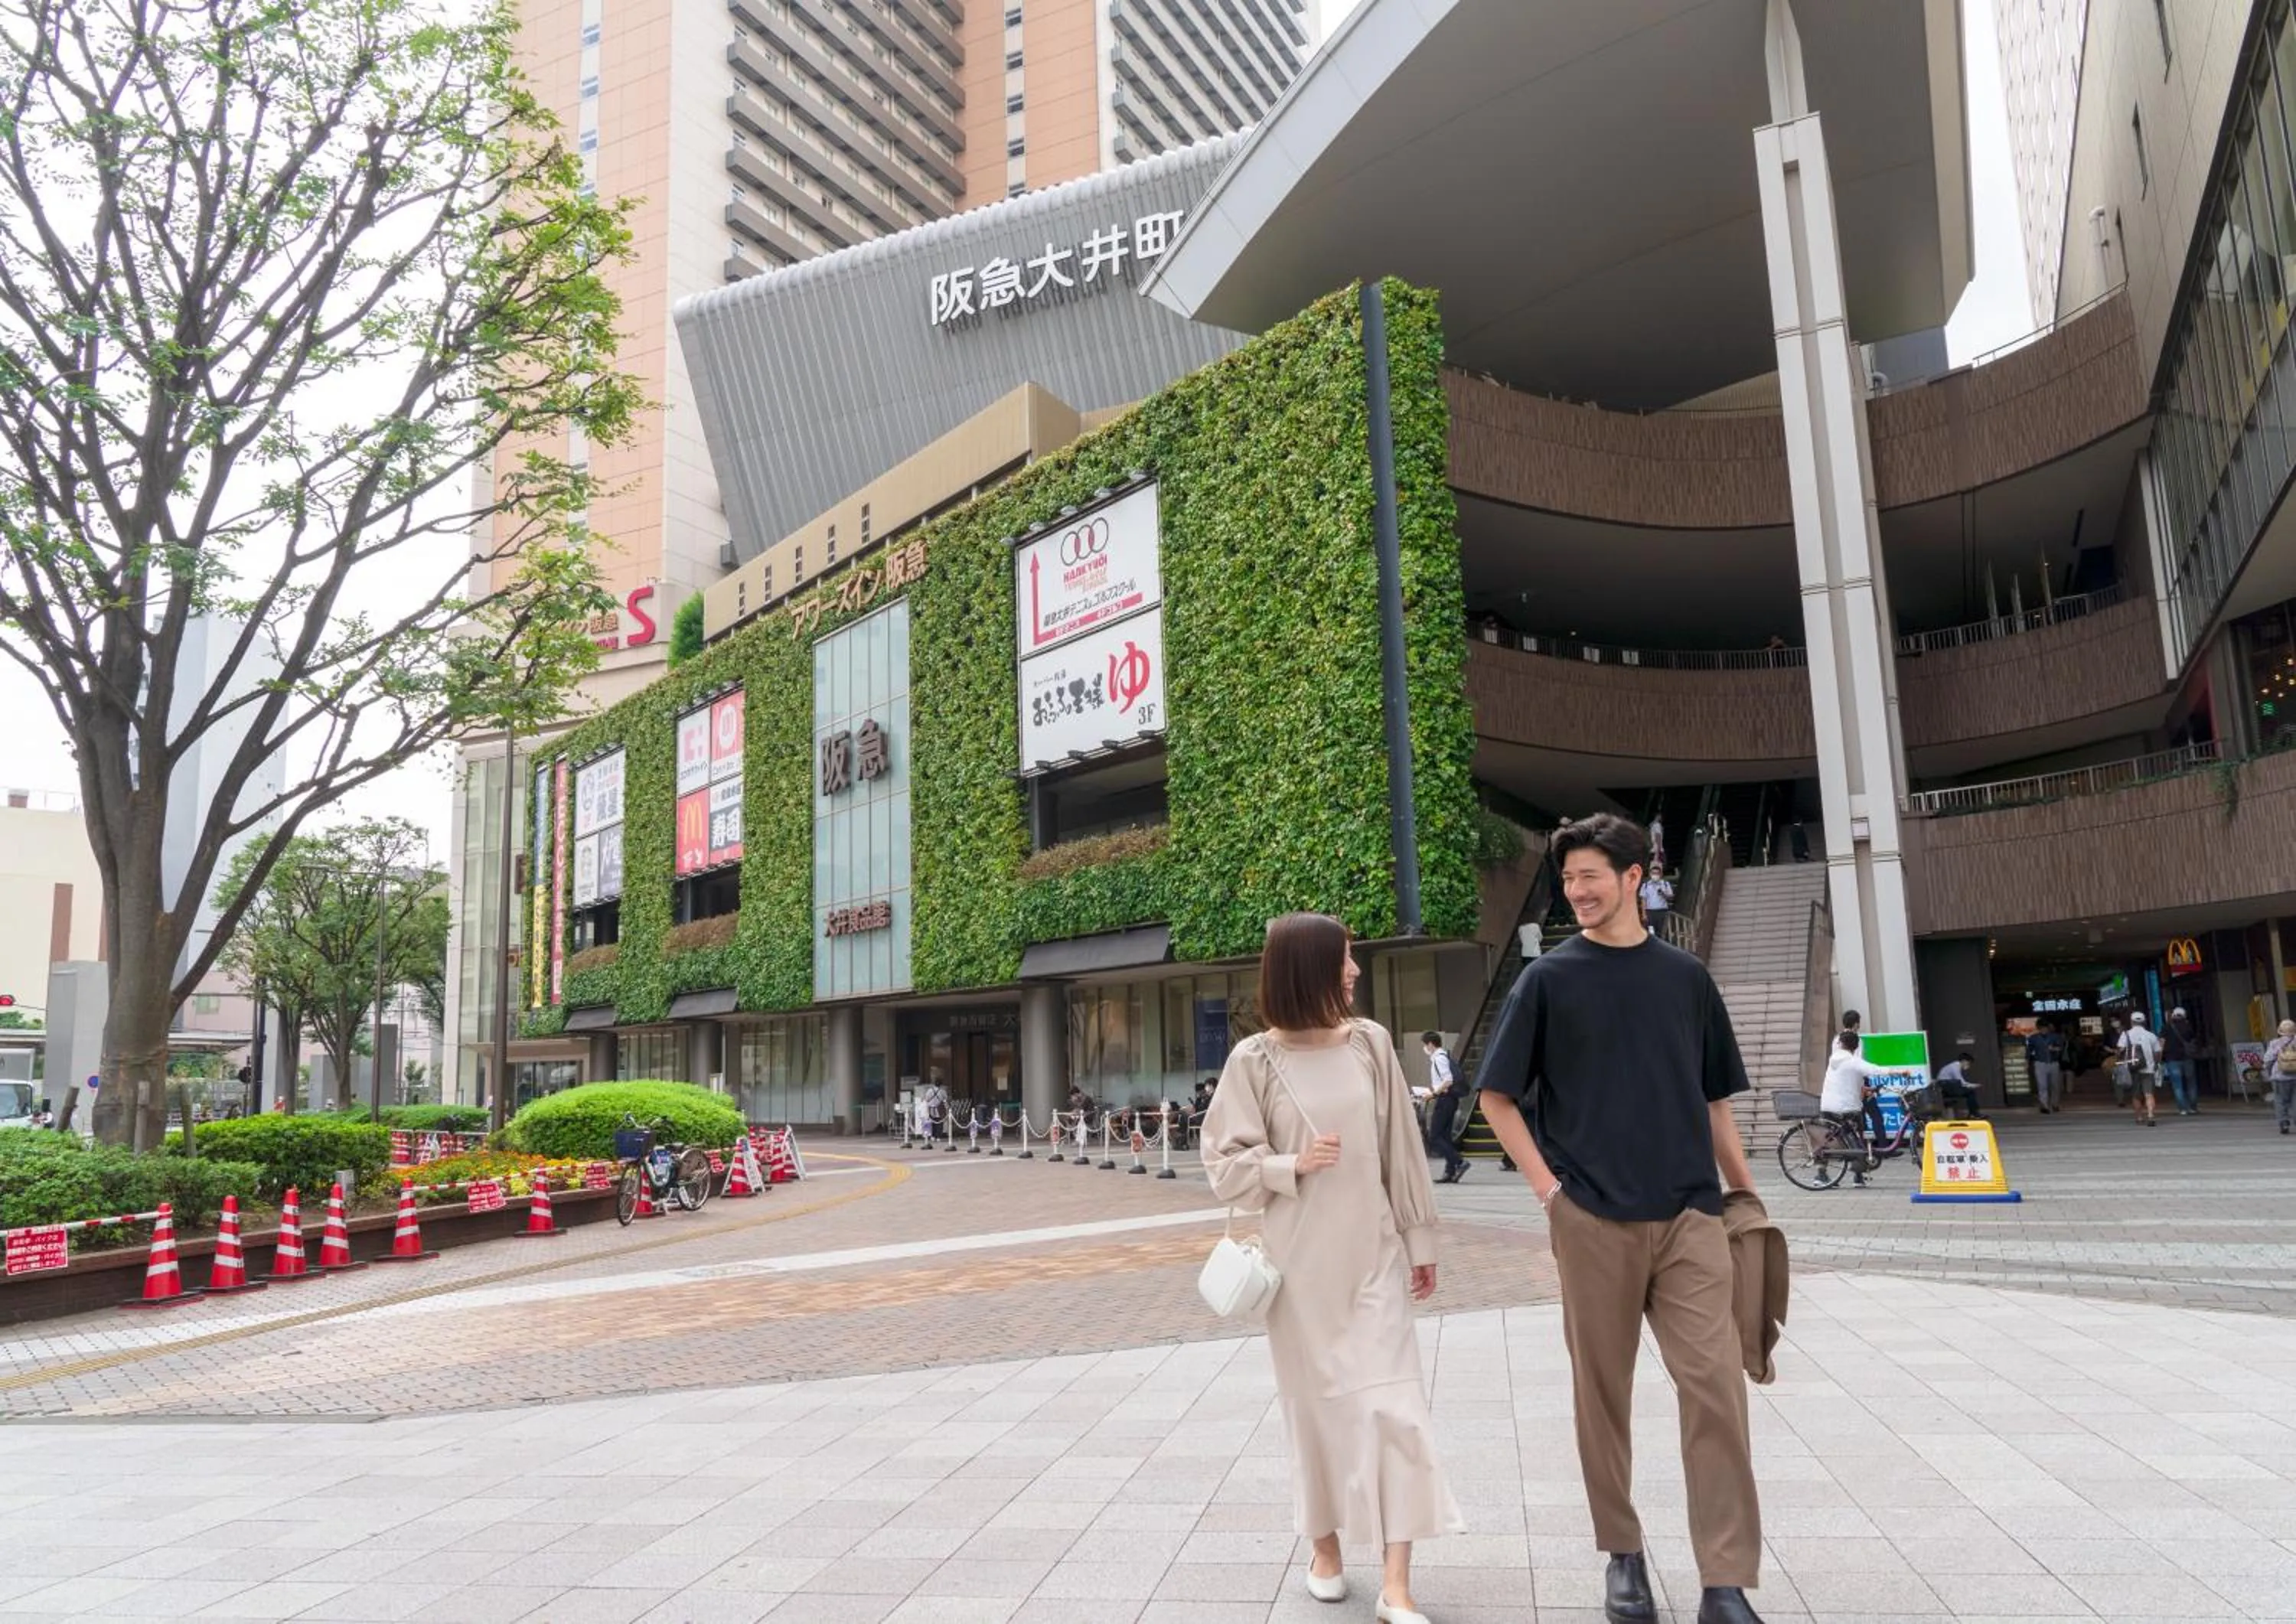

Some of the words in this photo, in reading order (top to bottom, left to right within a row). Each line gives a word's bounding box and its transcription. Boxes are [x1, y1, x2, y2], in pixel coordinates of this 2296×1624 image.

[931, 209, 1184, 325] 阪急大井町
[627, 586, 656, 647] S
[1108, 641, 1150, 715] ゆ
[1138, 703, 1156, 726] 3F
[820, 718, 891, 796] 阪急
[1947, 1166, 1981, 1181] 禁止
